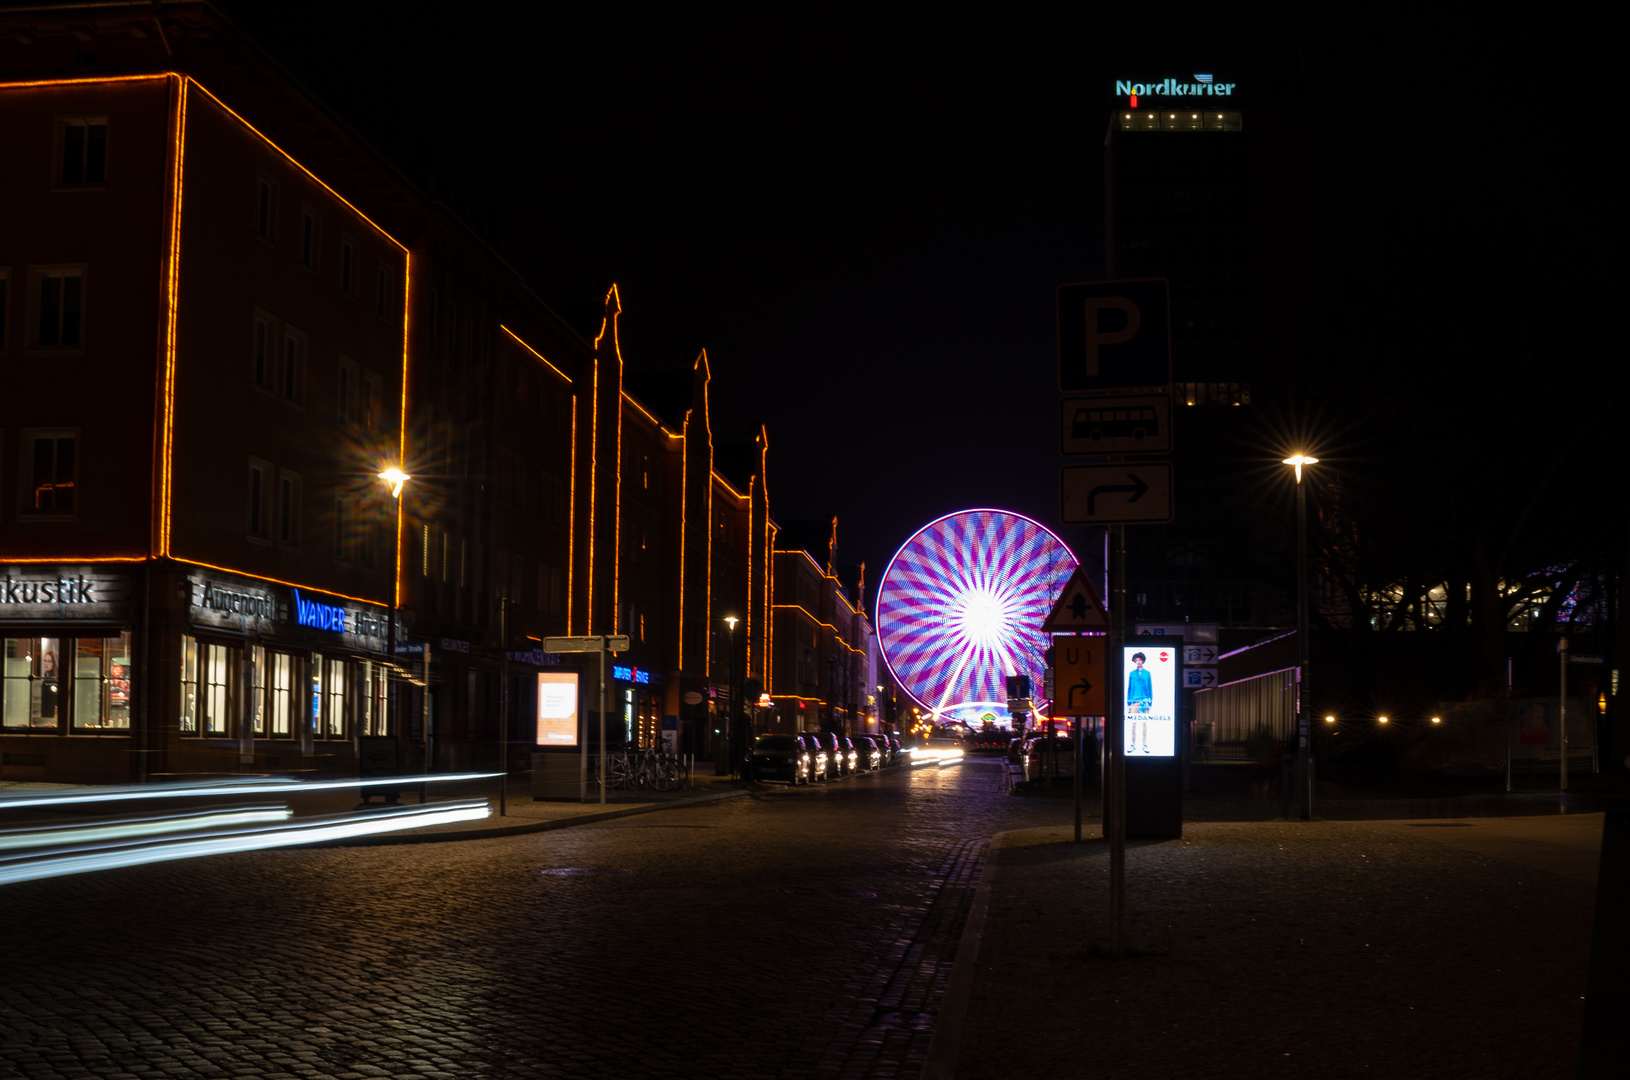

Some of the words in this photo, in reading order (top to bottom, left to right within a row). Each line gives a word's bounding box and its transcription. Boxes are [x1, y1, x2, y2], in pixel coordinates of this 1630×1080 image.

[1116, 79, 1236, 96] Nordkurier
[1084, 296, 1142, 376] P
[0, 574, 94, 603] kustik
[294, 588, 345, 634] WANDER
[1066, 648, 1079, 665] U
